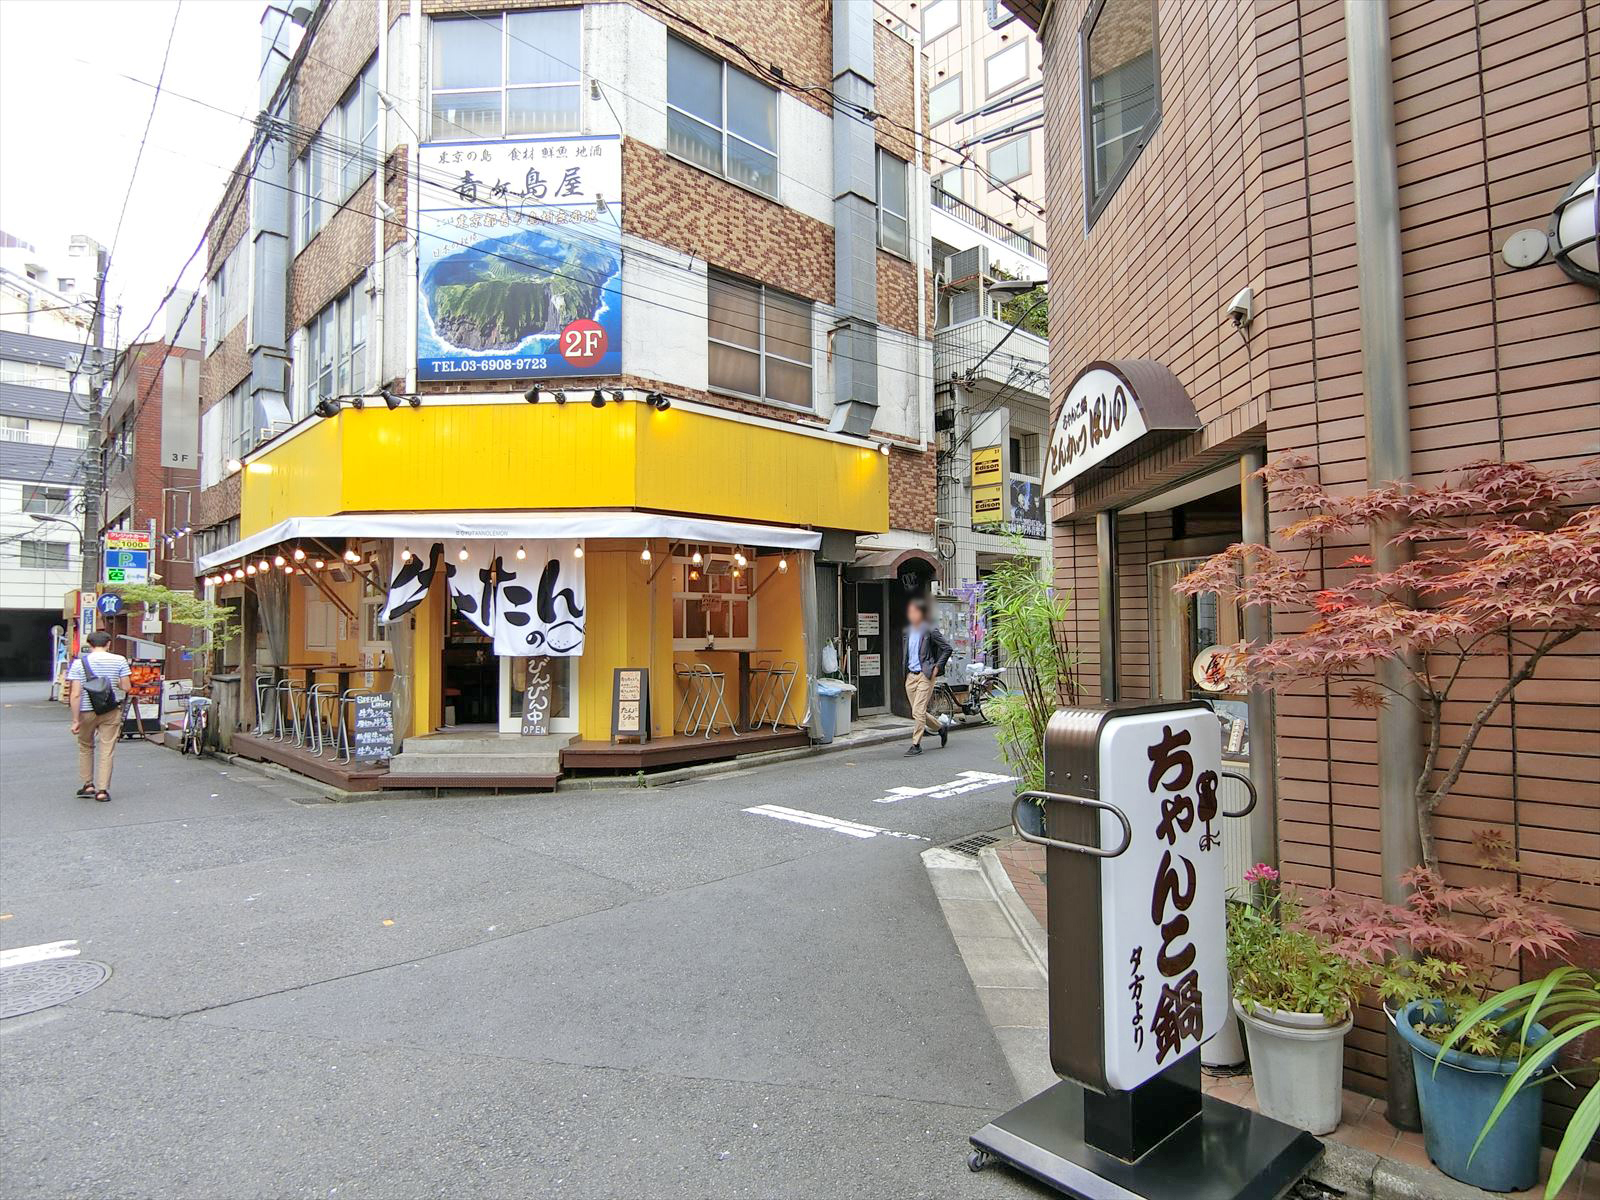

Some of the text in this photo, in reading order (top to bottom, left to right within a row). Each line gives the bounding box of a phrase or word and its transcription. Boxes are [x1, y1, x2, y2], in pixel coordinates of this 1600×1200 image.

[438, 144, 602, 165] 東京の島 食材 鮮魚 地酒
[565, 329, 602, 357] 2F
[432, 357, 547, 373] TEL.03-6908-9723
[1050, 384, 1128, 476] とんかつ ほしの
[975, 461, 1000, 472] Edison
[975, 500, 1001, 511] Edison
[102, 596, 119, 613] 質
[356, 694, 385, 704] SPECIAL
[523, 725, 546, 734] OPEN
[1146, 724, 1205, 1066] ちゃんこ鍋
[1128, 945, 1145, 1053] 夕方より
